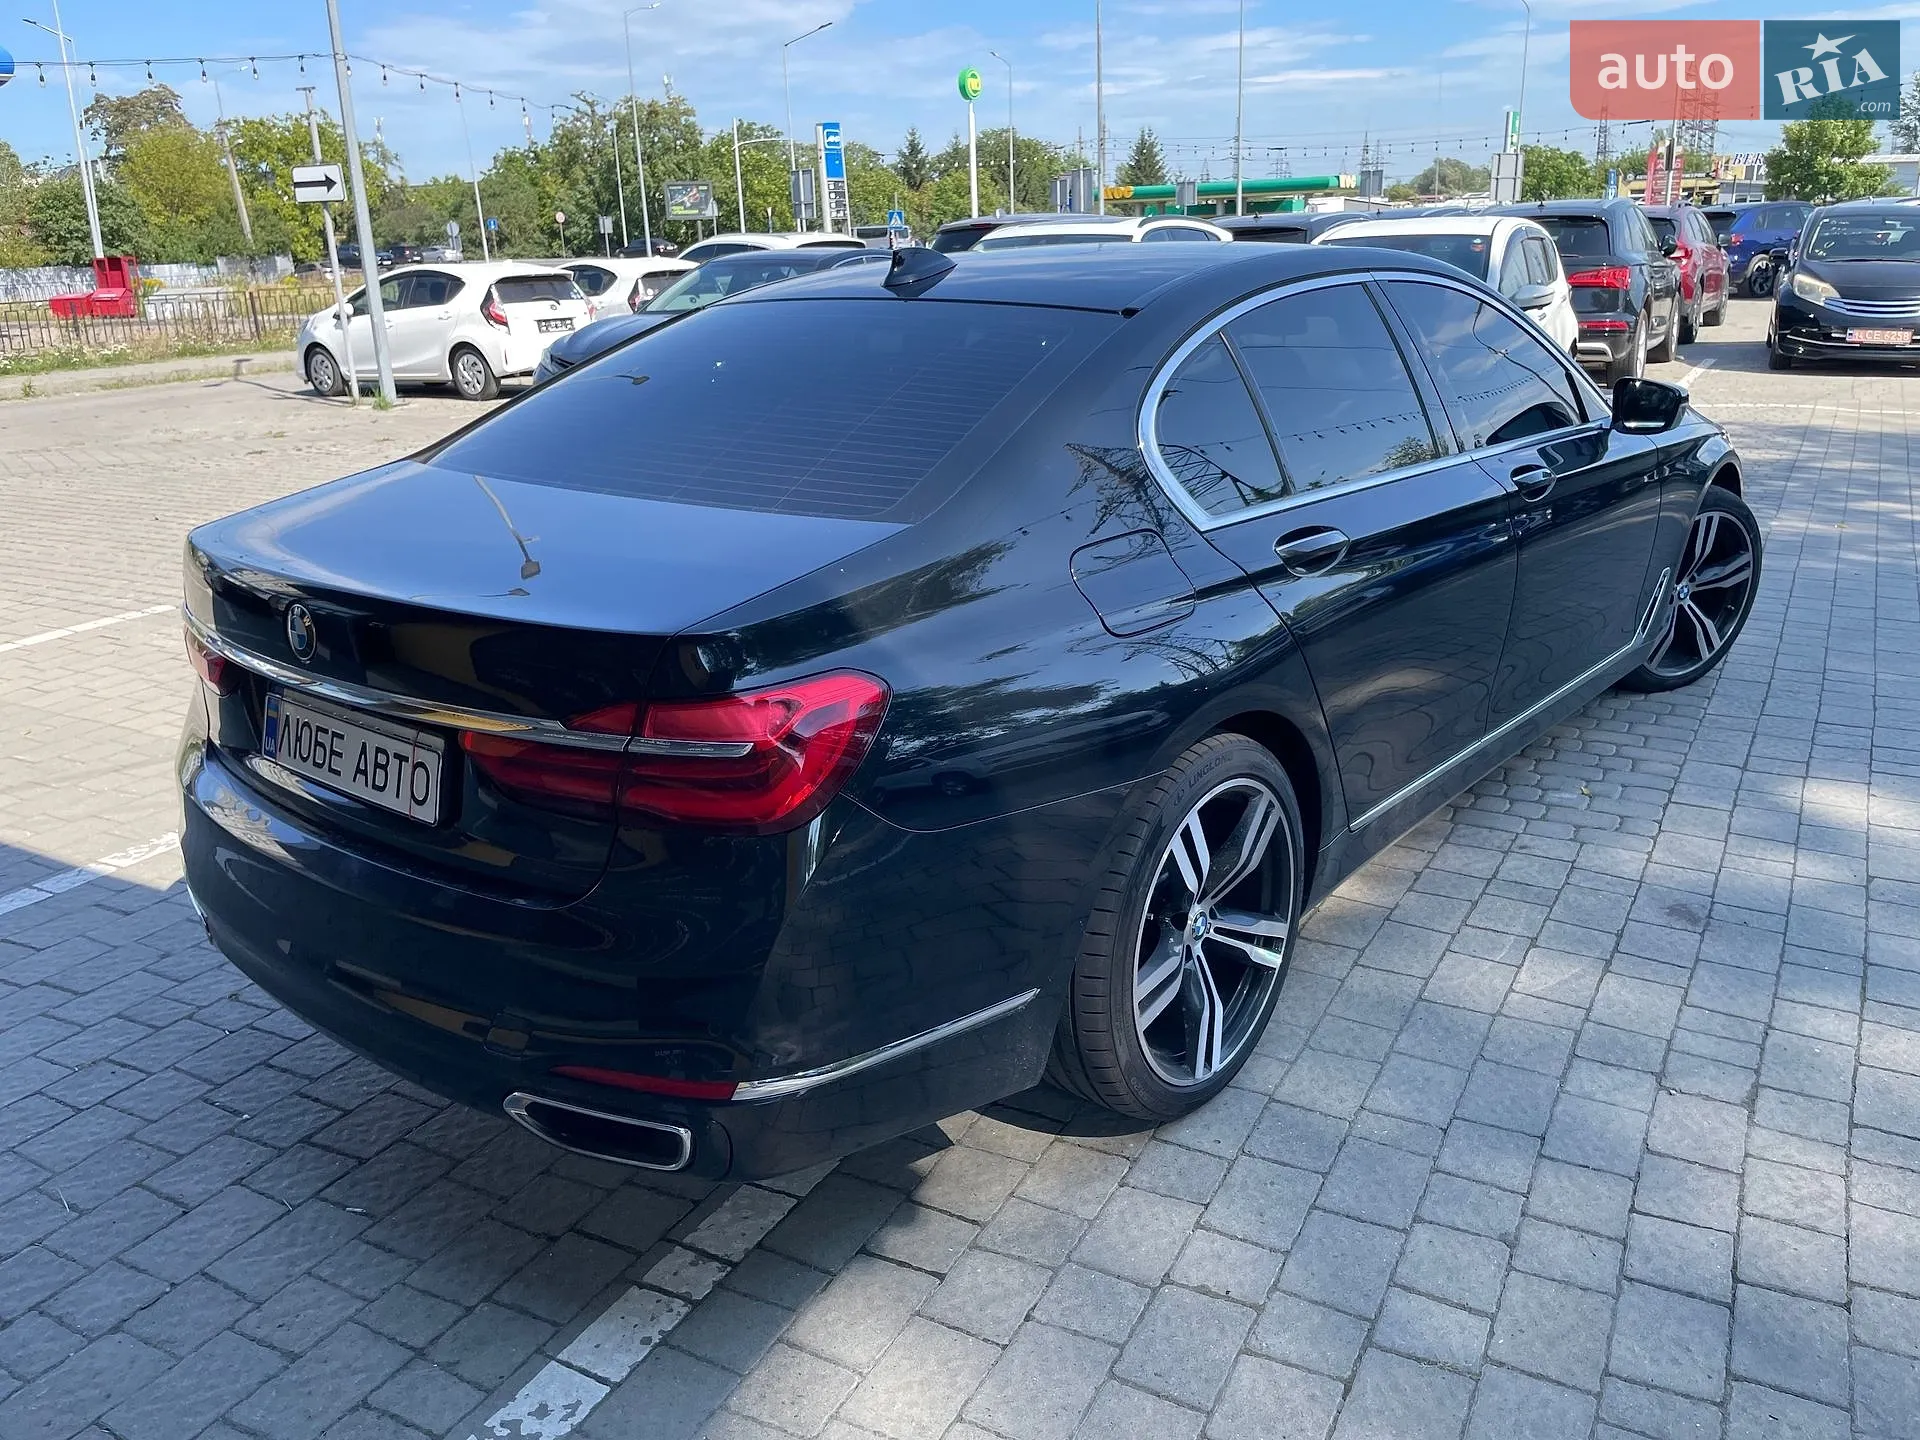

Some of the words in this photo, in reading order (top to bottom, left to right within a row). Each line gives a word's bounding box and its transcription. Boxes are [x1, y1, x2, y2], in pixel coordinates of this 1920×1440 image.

[264, 735, 276, 754] UA
[278, 713, 346, 777] ЛЮБЕ
[352, 741, 431, 807] АВТО
